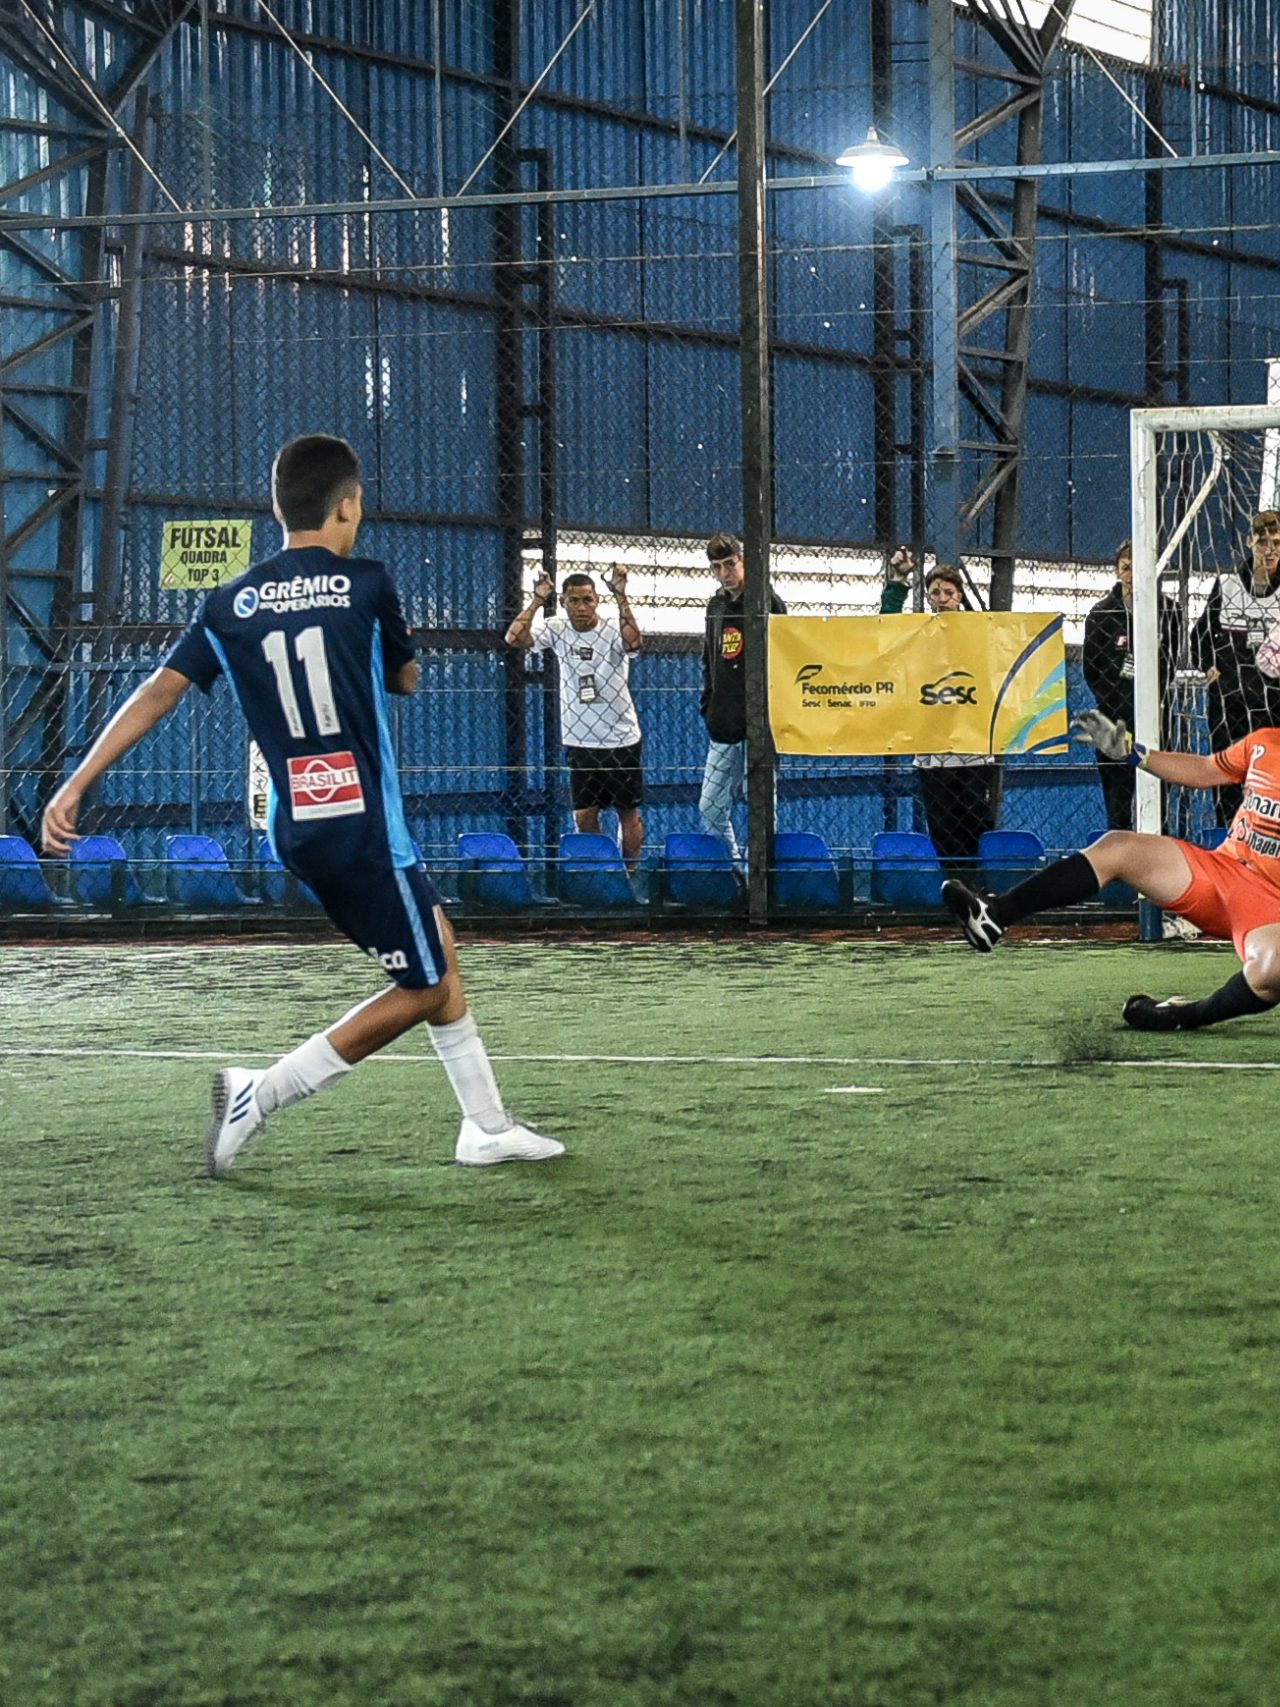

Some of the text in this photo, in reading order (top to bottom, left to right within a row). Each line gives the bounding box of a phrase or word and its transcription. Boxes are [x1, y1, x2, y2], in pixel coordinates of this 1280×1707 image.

[170, 527, 241, 549] FUTSAL
[180, 550, 228, 565] QUADRA
[188, 568, 220, 582] TOP 3
[260, 574, 352, 600] GRÊMIO
[261, 625, 342, 738] 11
[802, 681, 894, 695] Fecomércio PR
[802, 699, 821, 707] Sesc
[827, 699, 852, 708] Senac
[920, 682, 977, 705] Sesc
[291, 769, 358, 790] BRASILIT
